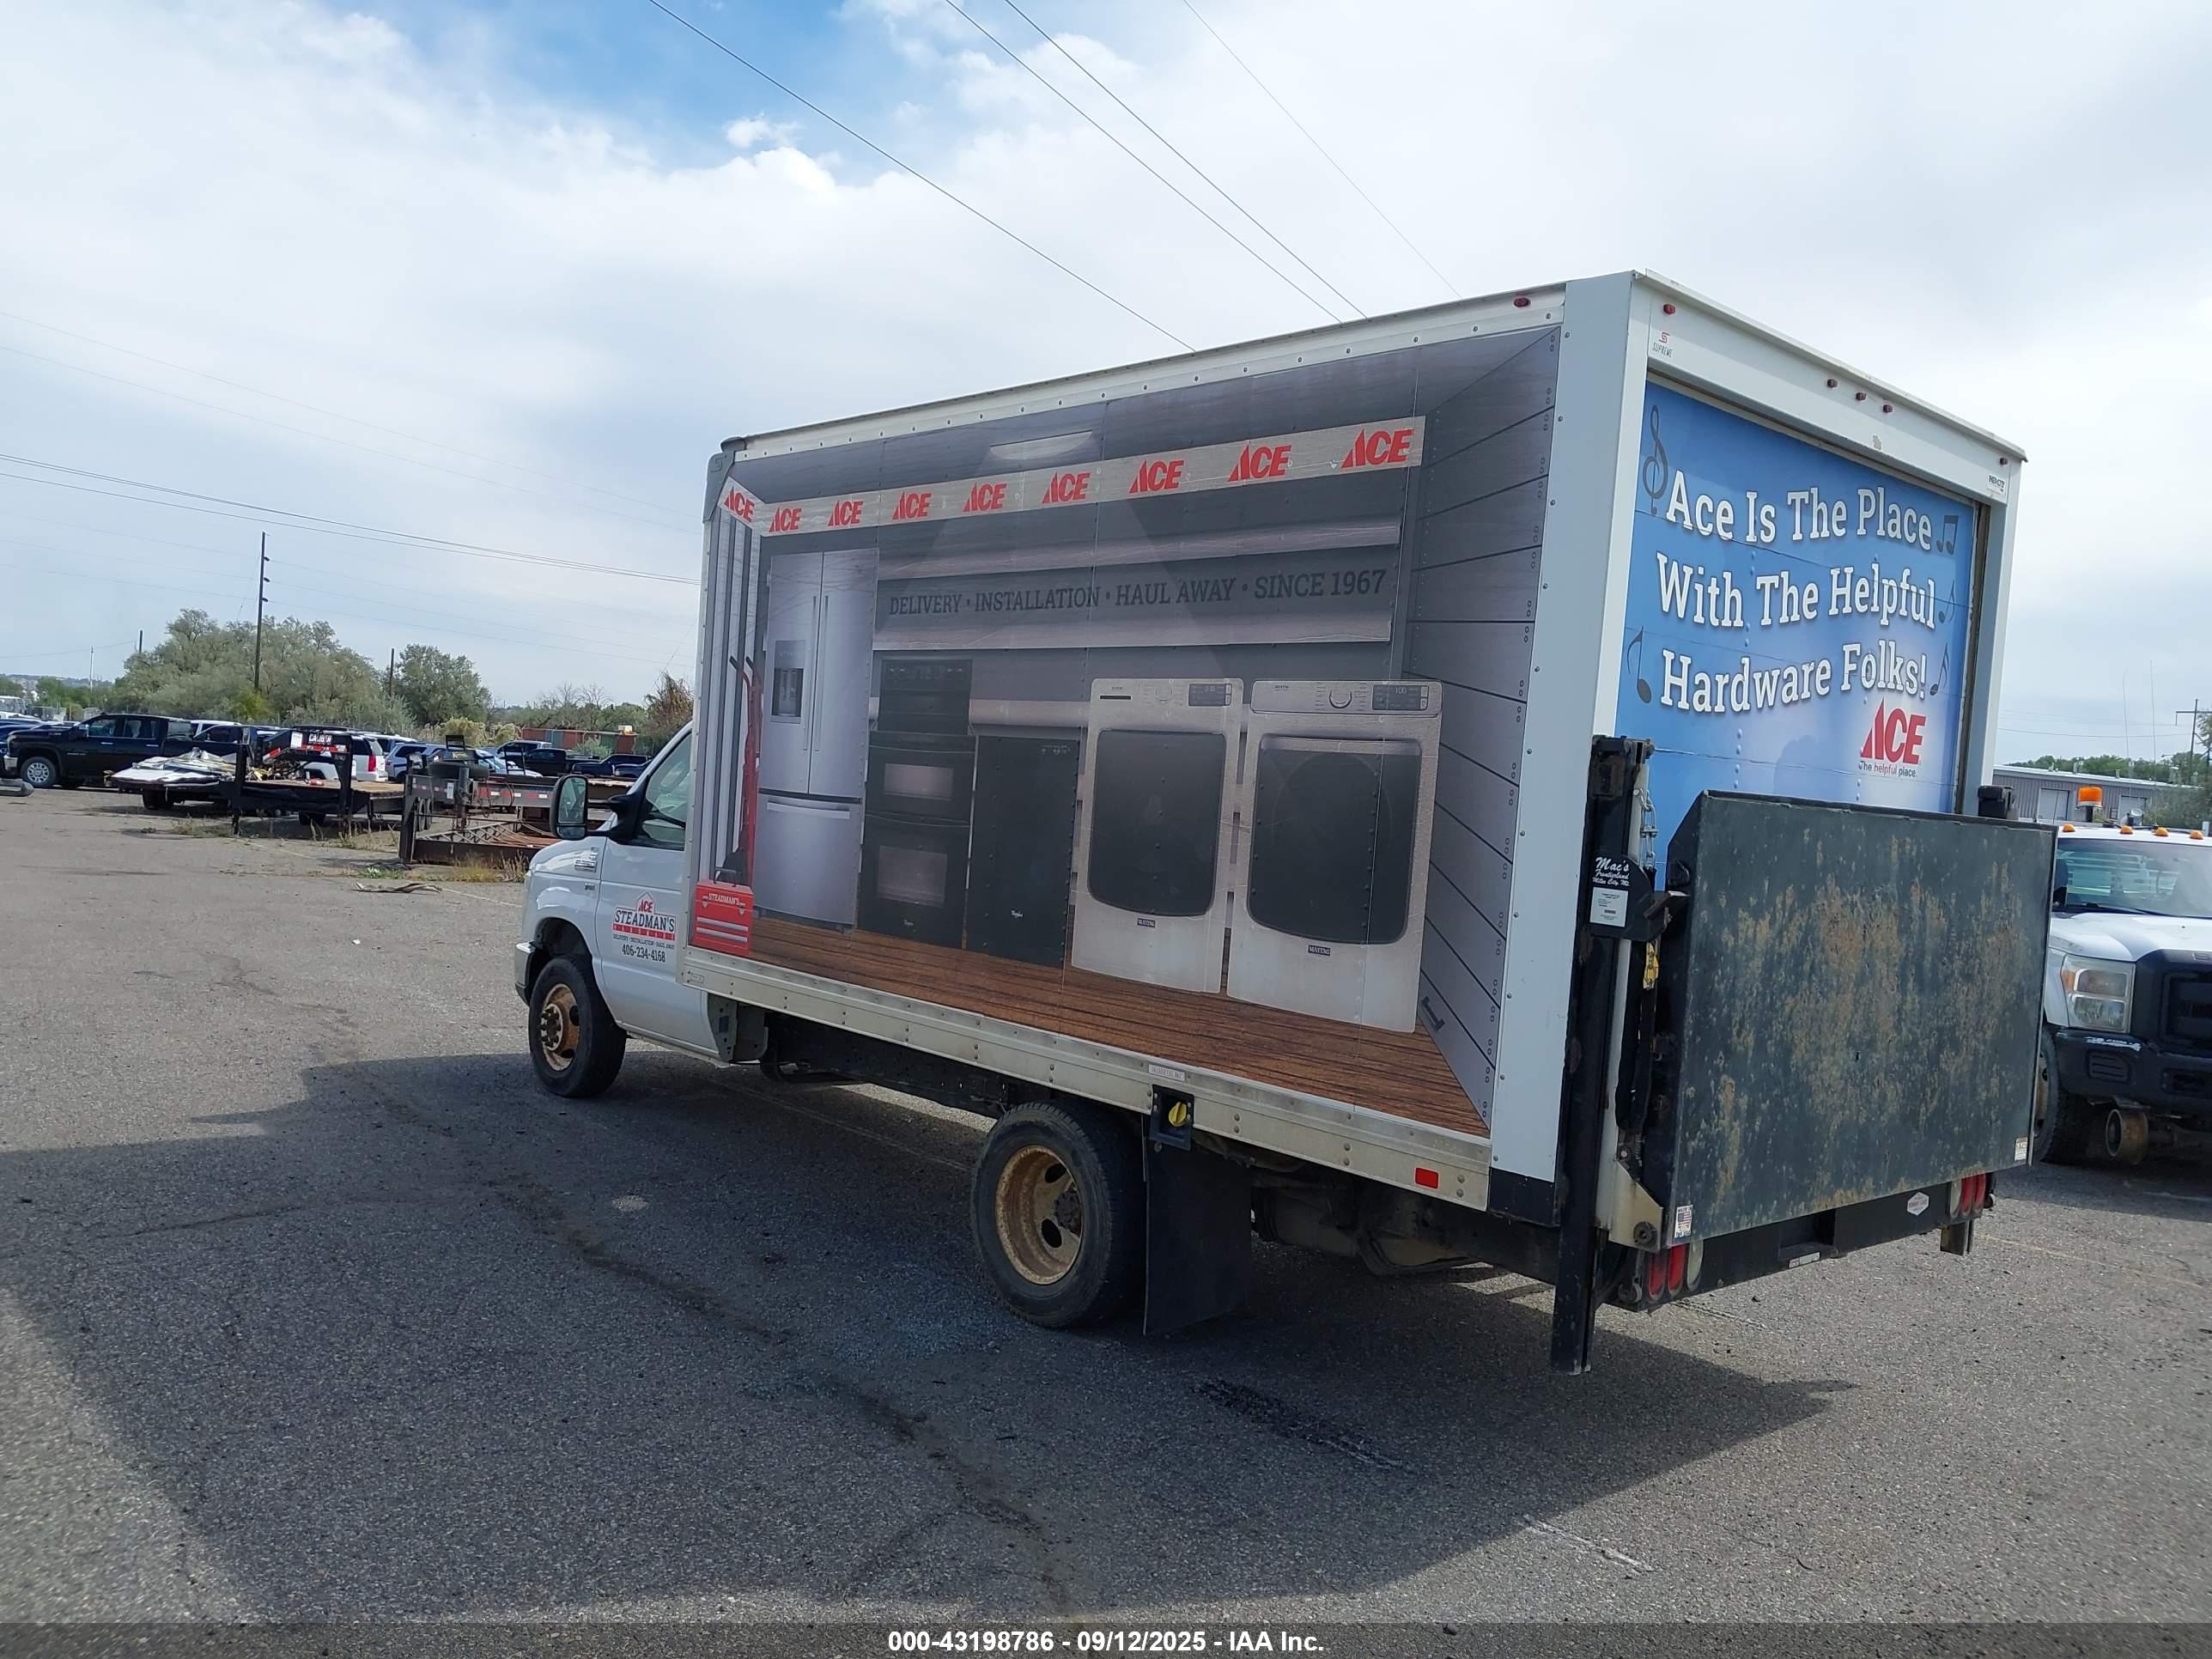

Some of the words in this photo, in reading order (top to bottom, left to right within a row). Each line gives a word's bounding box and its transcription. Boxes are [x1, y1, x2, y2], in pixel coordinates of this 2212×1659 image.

[724, 487, 756, 522] ACE
[769, 507, 803, 532] ACE
[828, 500, 864, 526] ACE
[892, 490, 932, 520] ACE
[963, 482, 1007, 513] ACE
[1042, 471, 1091, 504] ACE
[1129, 459, 1184, 494] ACE
[1229, 445, 1292, 482] ACE
[1341, 428, 1416, 469] ACE
[1666, 469, 1734, 542] Ace
[1745, 491, 1776, 543] Is
[1786, 487, 1847, 541] The
[1856, 486, 1931, 550] Place
[890, 593, 963, 615] DELIVERY
[975, 586, 1101, 612] INSTALLATION
[1115, 582, 1170, 606] HAUL
[1176, 577, 1237, 603] AWAY
[1254, 573, 1325, 599] SINCE
[1331, 568, 1387, 596] 1967
[1656, 551, 1744, 628] With
[1756, 570, 1819, 626] The
[1828, 562, 1936, 629] Helpful
[1660, 648, 1832, 713] Hardware
[1840, 639, 1927, 700] Folks!
[1860, 696, 1926, 765] ACE
[1860, 761, 1872, 771] The
[1874, 763, 1898, 776] helpful
[1595, 857, 1630, 872] Mac's
[638, 899, 653, 914] ACE
[708, 892, 740, 906] STEADMAN'S
[614, 909, 675, 933] STEADMAN'S
[622, 944, 666, 963] 406-234-4168
